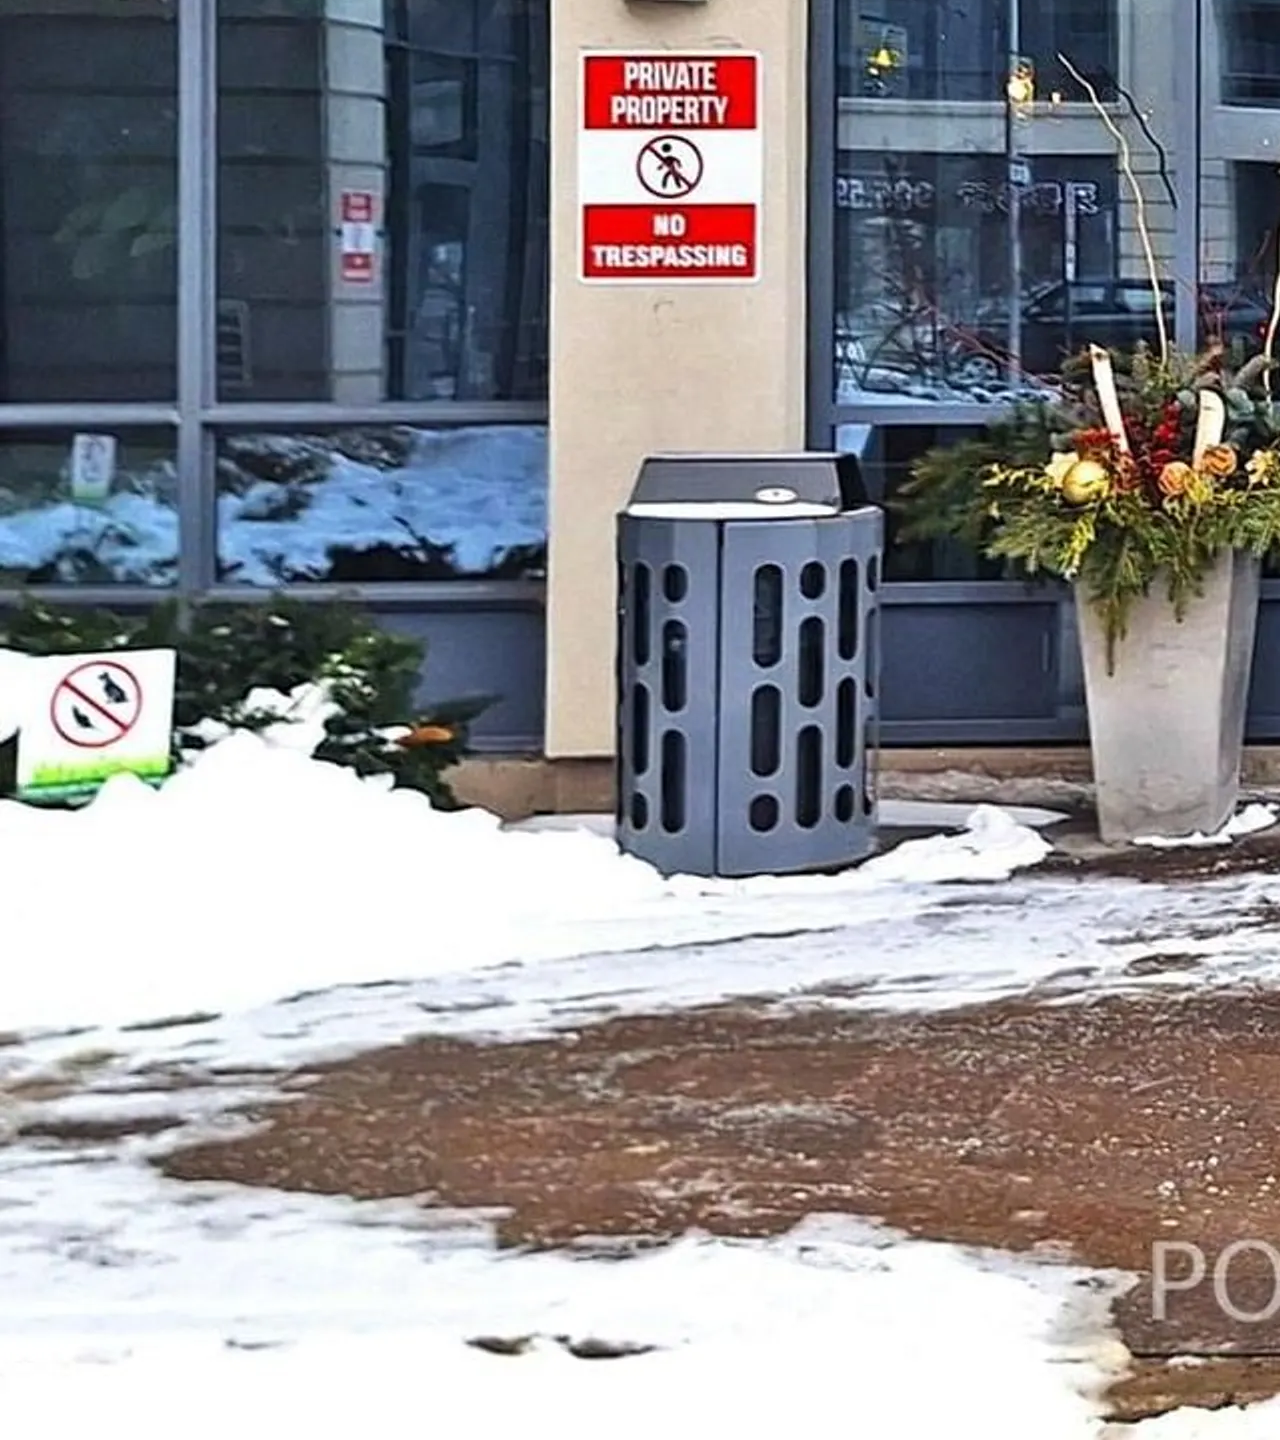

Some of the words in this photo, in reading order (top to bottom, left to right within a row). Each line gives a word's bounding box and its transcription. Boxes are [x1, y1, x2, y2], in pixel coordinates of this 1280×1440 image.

[623, 61, 718, 91] PRIVATE
[610, 95, 728, 124] PROPERTY
[653, 213, 686, 236] NO
[591, 245, 747, 268] TRESPASSING
